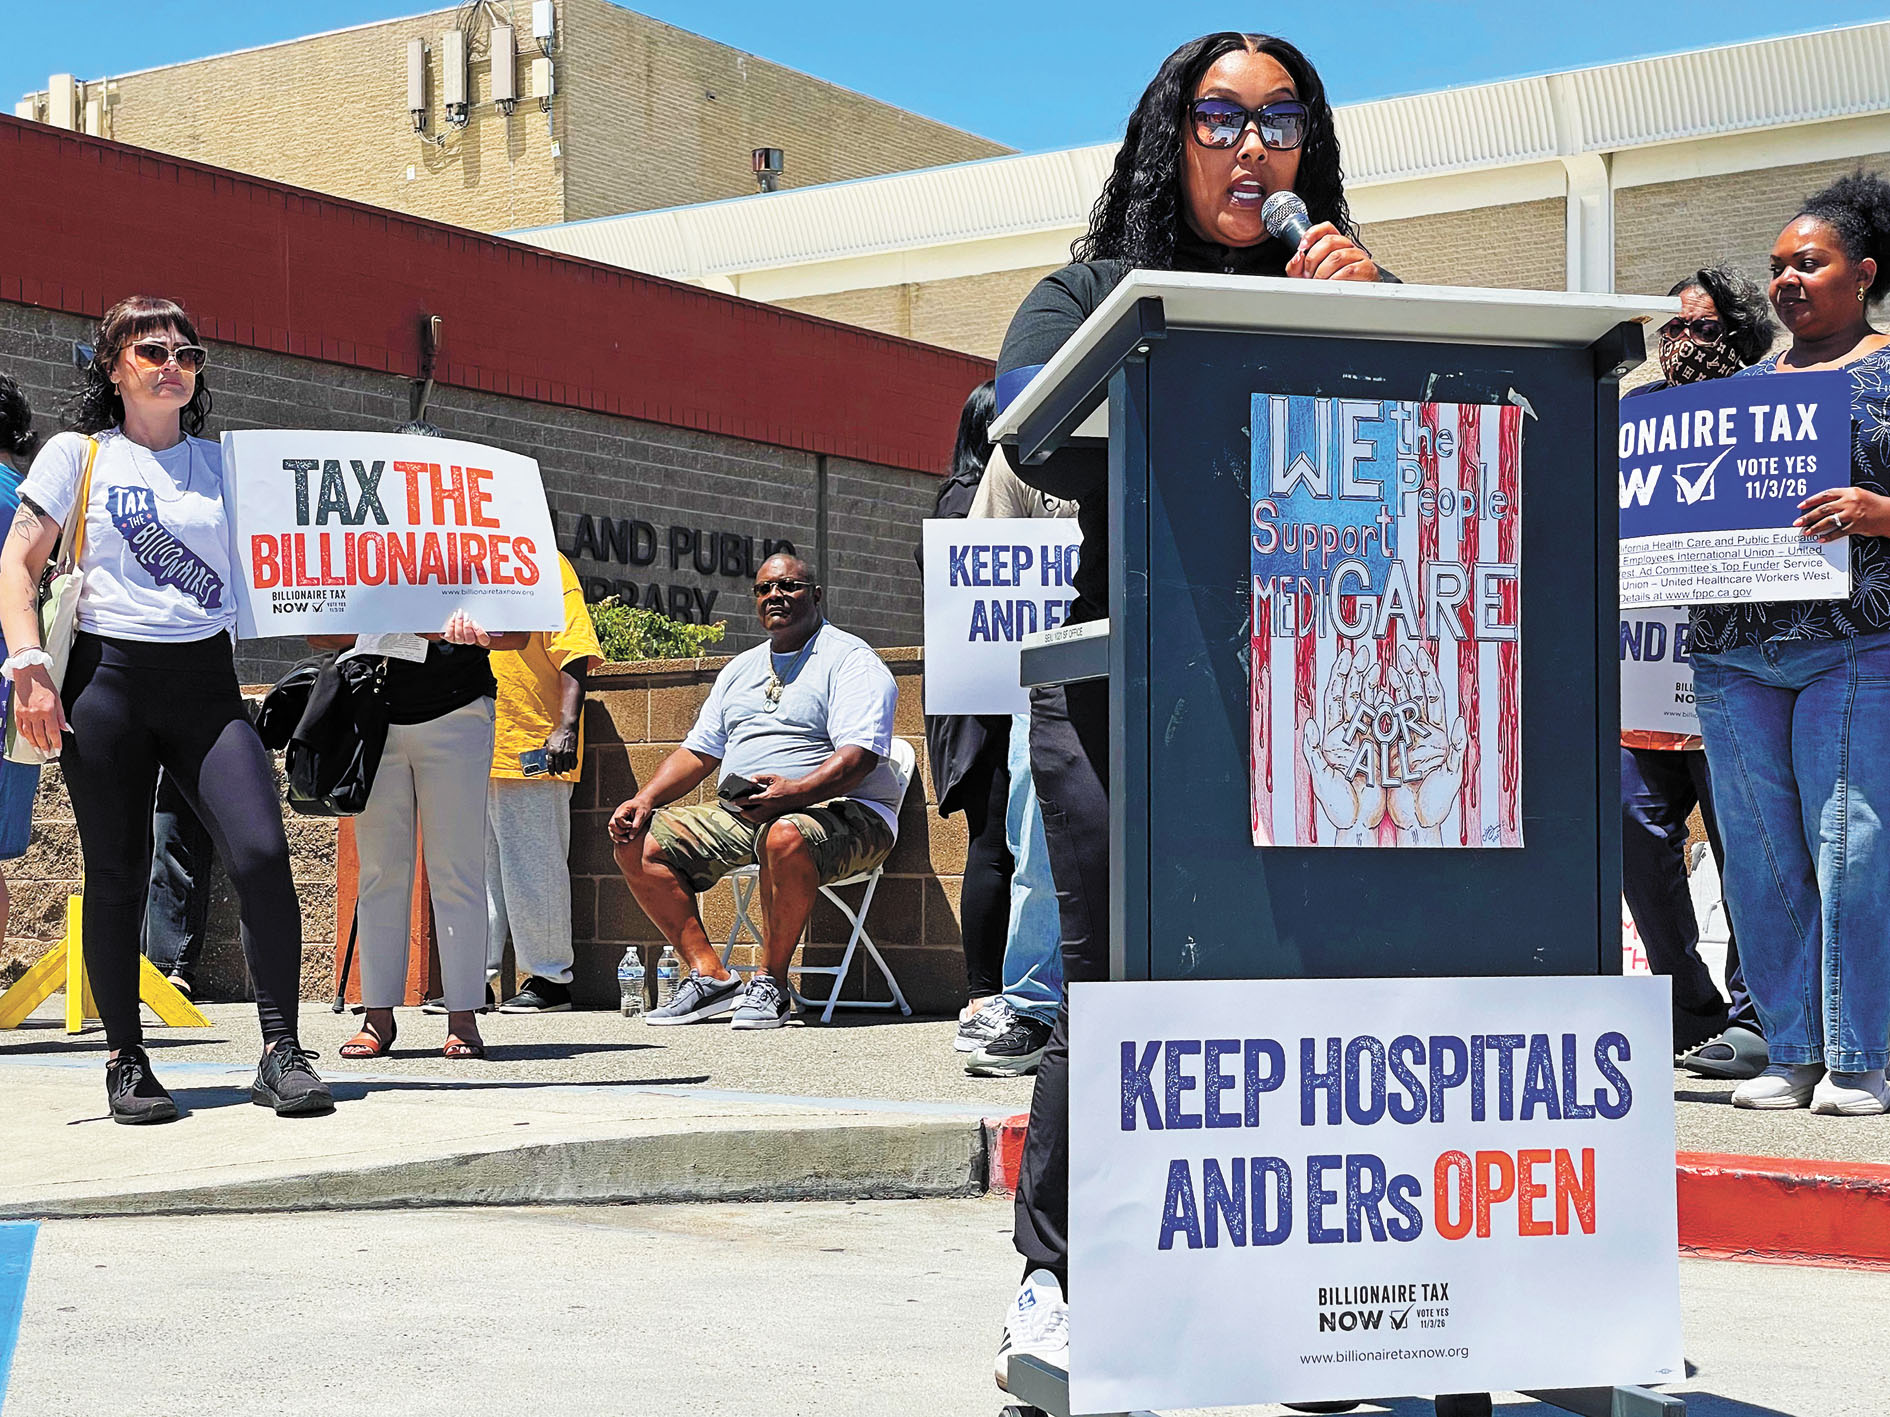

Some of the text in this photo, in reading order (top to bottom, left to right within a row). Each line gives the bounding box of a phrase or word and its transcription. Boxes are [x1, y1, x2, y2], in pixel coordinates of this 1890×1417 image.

[1390, 401, 1453, 458] the
[1749, 404, 1818, 443] TAX
[1269, 395, 1384, 501] WE
[1737, 456, 1817, 477] VOTE YES
[282, 459, 500, 528] TAX THE
[1397, 458, 1508, 542] People
[1745, 479, 1807, 499] 11/3/26
[115, 488, 148, 517] TAX
[128, 514, 146, 528] THE
[1252, 499, 1394, 570] Support
[1652, 540, 1683, 550] Health
[1687, 538, 1711, 547] Care
[1714, 536, 1734, 546] and
[1738, 534, 1769, 544] Public
[133, 522, 217, 605] BILLIONAIRES
[250, 532, 540, 590] BILLIONAIRES
[950, 545, 1033, 586] KEEP
[1623, 554, 1674, 565] Employees
[1677, 549, 1740, 560] International
[1744, 548, 1774, 557] Union
[1788, 545, 1822, 556] United
[1640, 567, 1652, 576] Ad
[1656, 564, 1718, 574] Committee's
[1721, 562, 1740, 572] Top
[1742, 560, 1780, 570] Funder
[1784, 558, 1822, 568] Service
[1622, 581, 1648, 590] Union
[1660, 578, 1692, 587] United
[1696, 575, 1752, 585] Healthcare
[1756, 573, 1799, 582] Workers
[272, 590, 346, 601] BILLIONAIRE TAX
[272, 602, 308, 614] NOW
[1654, 592, 1662, 600] at
[968, 600, 1037, 641] AND
[1342, 699, 1432, 747] FOR
[1345, 739, 1422, 788] ALL
[1120, 1031, 1632, 1132] KEEP HOSPITALS
[1158, 1148, 1596, 1250] AND ERs OPEN
[1318, 1283, 1449, 1306] BILLIONAIRE TAX
[1320, 1310, 1384, 1332] NOW
[1416, 1308, 1449, 1318] VOTE YES
[1420, 1319, 1446, 1328] 11/3/26
[1300, 1347, 1469, 1364] www.billionairetaxnow.org
